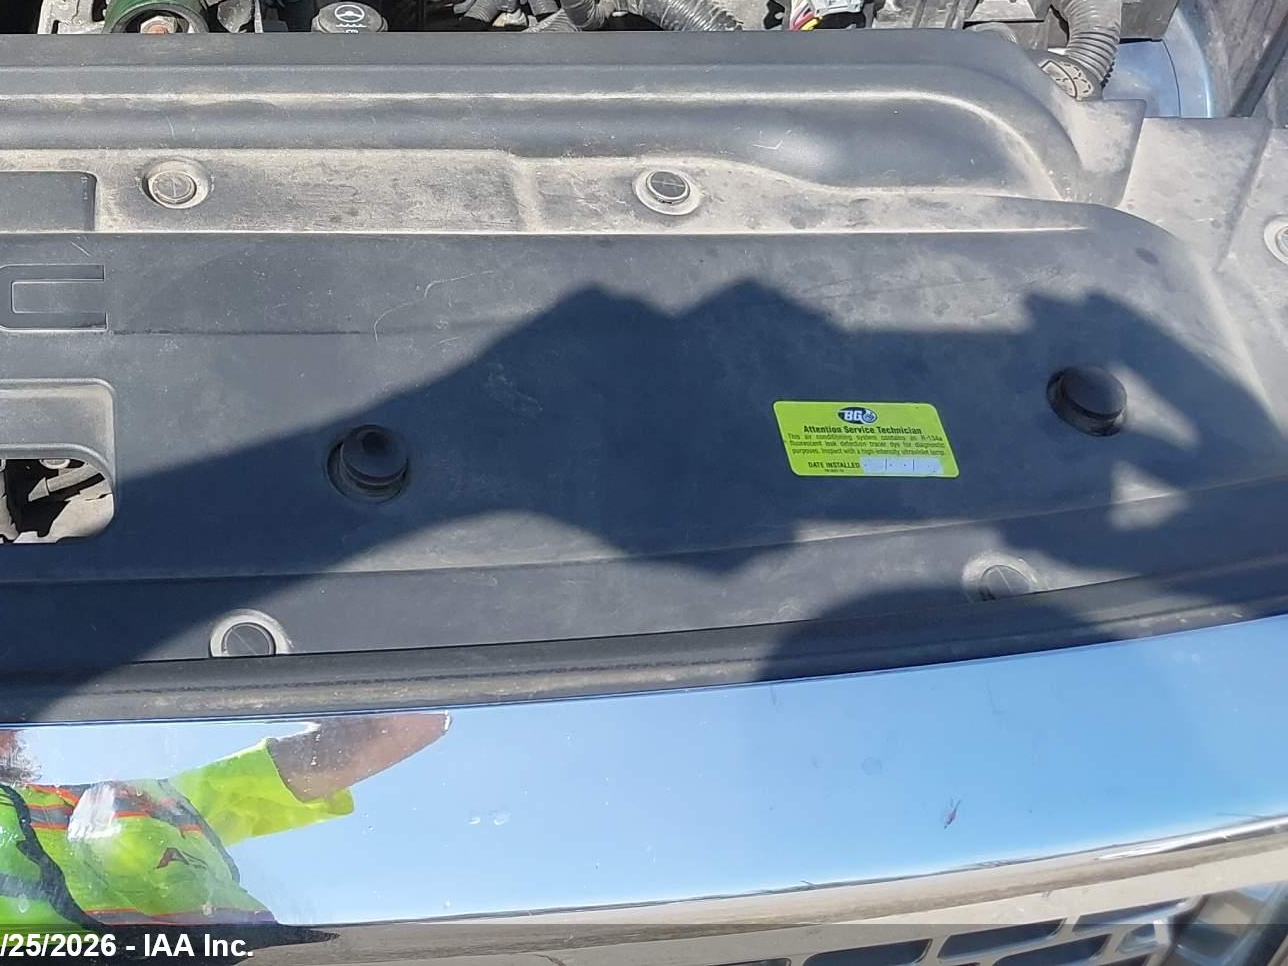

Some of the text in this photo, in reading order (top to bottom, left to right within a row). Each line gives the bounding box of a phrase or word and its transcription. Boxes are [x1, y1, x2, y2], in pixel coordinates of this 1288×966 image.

[844, 410, 863, 421] BG
[803, 425, 922, 435] Attention Service Technician
